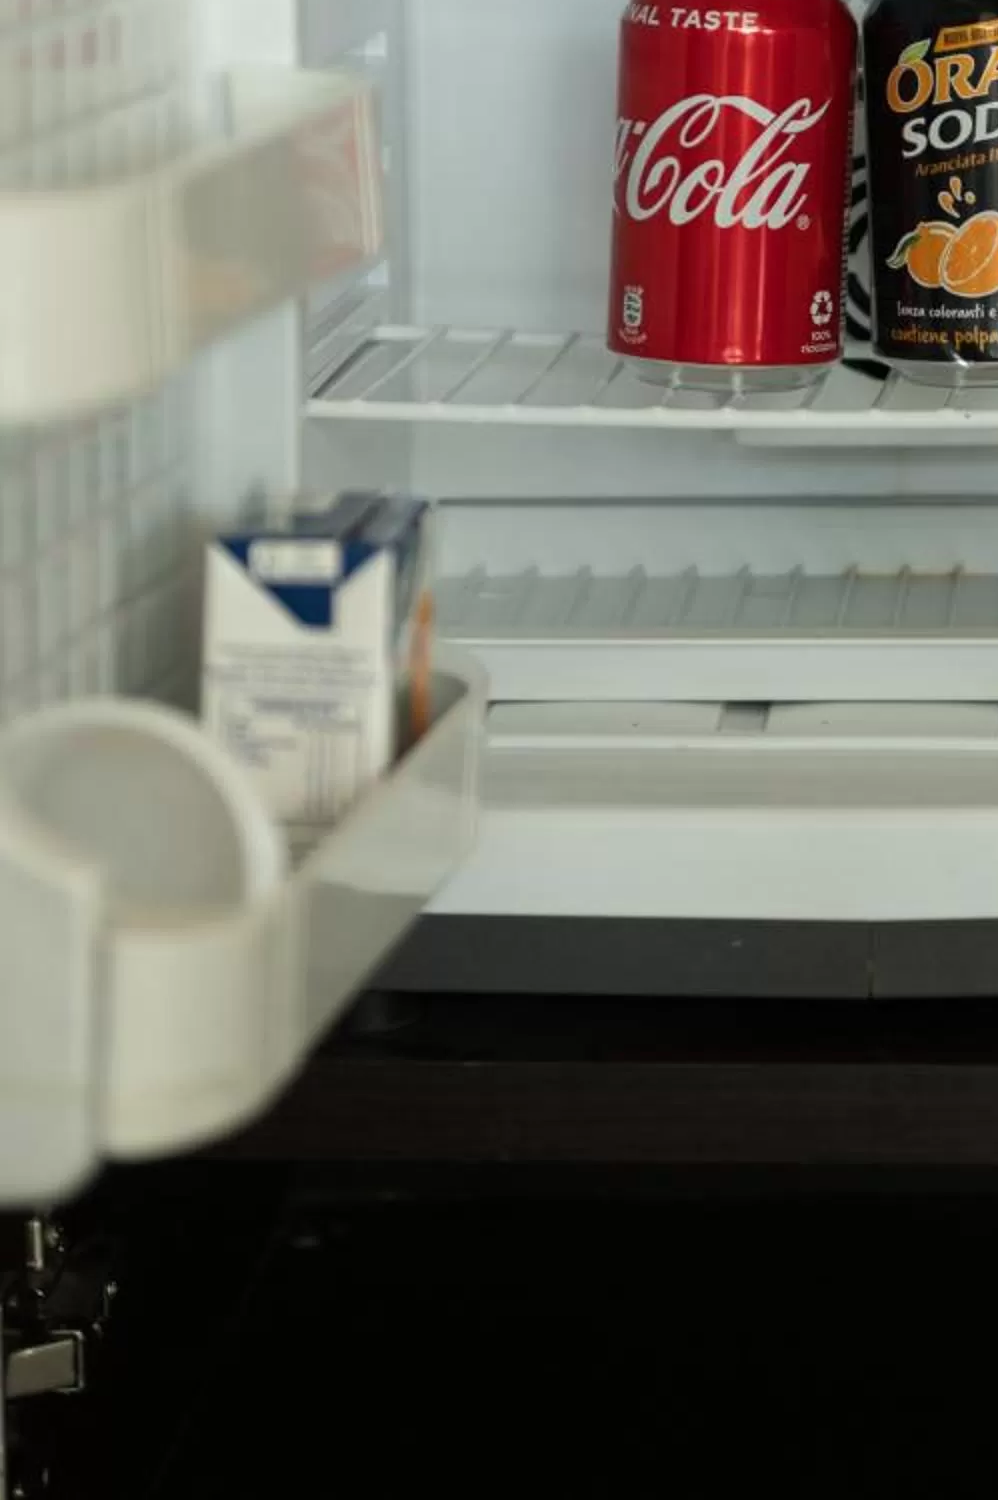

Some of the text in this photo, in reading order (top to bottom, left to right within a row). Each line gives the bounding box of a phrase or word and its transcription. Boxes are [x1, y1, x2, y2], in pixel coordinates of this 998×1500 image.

[915, 152, 986, 178] Aranciata
[928, 303, 985, 319] coloranti
[988, 307, 996, 319] e
